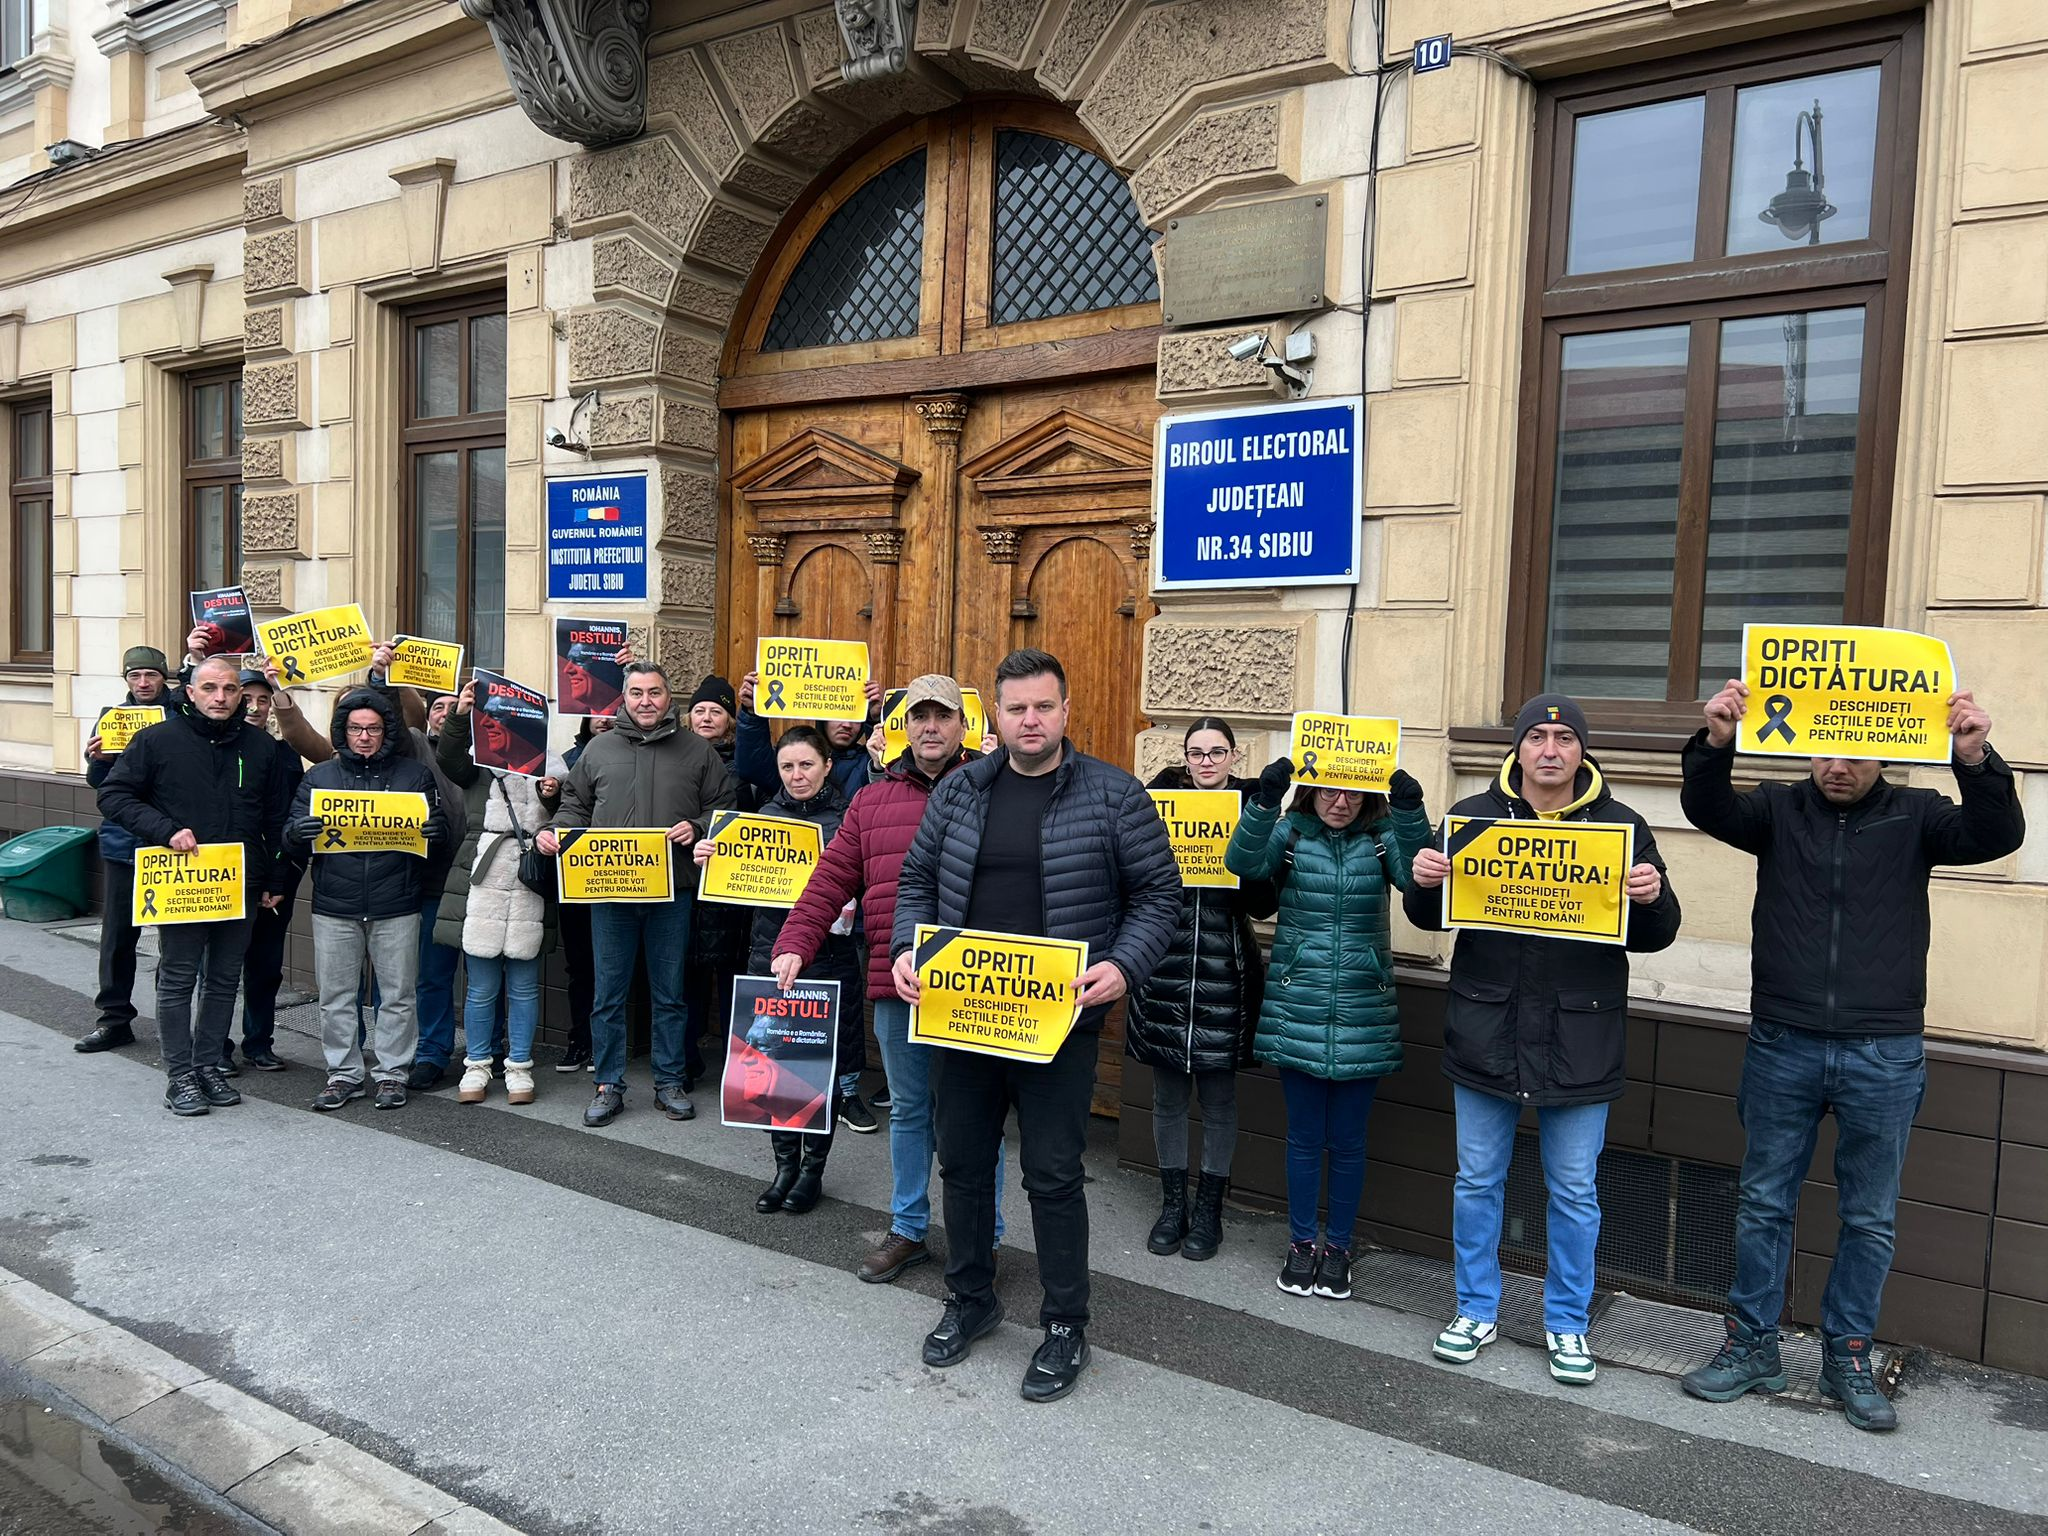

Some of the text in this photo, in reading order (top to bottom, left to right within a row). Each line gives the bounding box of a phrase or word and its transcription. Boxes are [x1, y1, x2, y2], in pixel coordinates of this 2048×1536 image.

[1420, 40, 1442, 66] 10
[1170, 428, 1349, 467] BIROUL ELECTORAL
[572, 486, 620, 502] ROMÂNIA
[1207, 482, 1304, 518] JUDEȚEAN
[552, 526, 642, 539] GUVERNUL ROMÂNIEI
[1197, 531, 1312, 561] NR.34 SIBIU
[551, 546, 642, 565] INSTITUȚIA PREFECTULUI
[569, 573, 623, 591] JUDEȚUL SIBIU
[273, 624, 362, 655] DICTATURA!
[570, 631, 621, 645] DESTUL!
[340, 650, 349, 659] DE
[350, 648, 363, 656] VOT
[1761, 638, 1855, 665] OPRIȚI
[310, 662, 338, 674] PENTRU
[394, 653, 451, 669] DICTATURA!
[765, 662, 861, 680] DICTATURA!
[1760, 664, 1939, 693] DICTATURA!
[804, 684, 847, 694] DESCHIDEȚI
[824, 702, 856, 711] ROMÂNI!
[1830, 700, 1911, 717] DESCHIDEȚI
[1814, 715, 1926, 729] SECȚIILE DE VOT
[1301, 734, 1390, 754] DICTATURA!
[1809, 730, 1927, 744] PENTRU ROMÂNI!
[1336, 757, 1376, 767] DESCHIDEȚI
[321, 814, 419, 829] DICTATURA!
[718, 842, 812, 865] DICTATURA!
[1498, 836, 1576, 864] OPRIȚI
[570, 854, 659, 866] DICTATURA!
[142, 868, 236, 885] DICTATURA!
[740, 863, 786, 876] DESCHIDEȚI
[1187, 865, 1224, 875] ROMÂNI!
[1464, 858, 1609, 885] DICTATURA!
[730, 873, 763, 884] SECȚIILE
[778, 877, 793, 886] VOT
[176, 887, 223, 896] DESCHIDEȚI
[727, 883, 792, 896] PENTRU ROMÂNI!
[1501, 885, 1570, 902] DESCHIDEȚI
[167, 898, 201, 906] SECȚIILE
[1488, 895, 1582, 910] SECȚIILE DE VOT
[1484, 906, 1584, 924] PENTRU ROMÂNI!
[962, 948, 1034, 979] OPRIȚI
[930, 970, 1064, 1002] DICTATURA!
[784, 990, 830, 1001] IOHANNIS,
[754, 998, 828, 1018] DESTUL!
[964, 998, 1028, 1016] DESCHIDEȚI
[952, 1009, 1039, 1029] SECȚIILE DE VOT
[949, 1022, 1038, 1045] PENTRU ROMÂNI!
[1051, 1324, 1071, 1336] EA7
